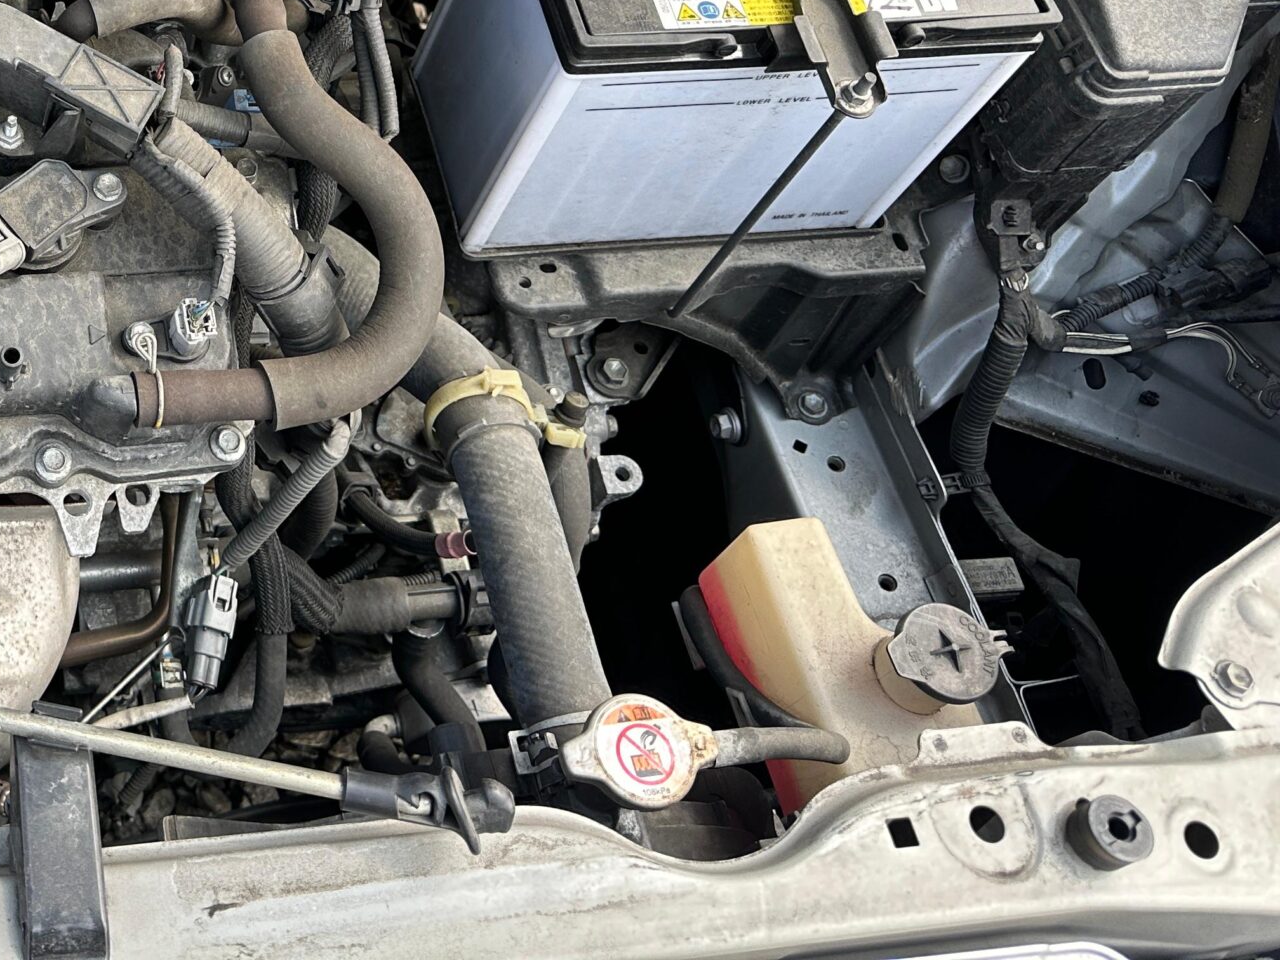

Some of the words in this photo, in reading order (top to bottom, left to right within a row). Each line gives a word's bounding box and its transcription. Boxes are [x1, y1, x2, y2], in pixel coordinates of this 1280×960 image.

[755, 73, 790, 81] UPPER
[736, 98, 771, 106] LOWER
[779, 96, 812, 104] LEVEL
[959, 615, 995, 678] COOLANT
